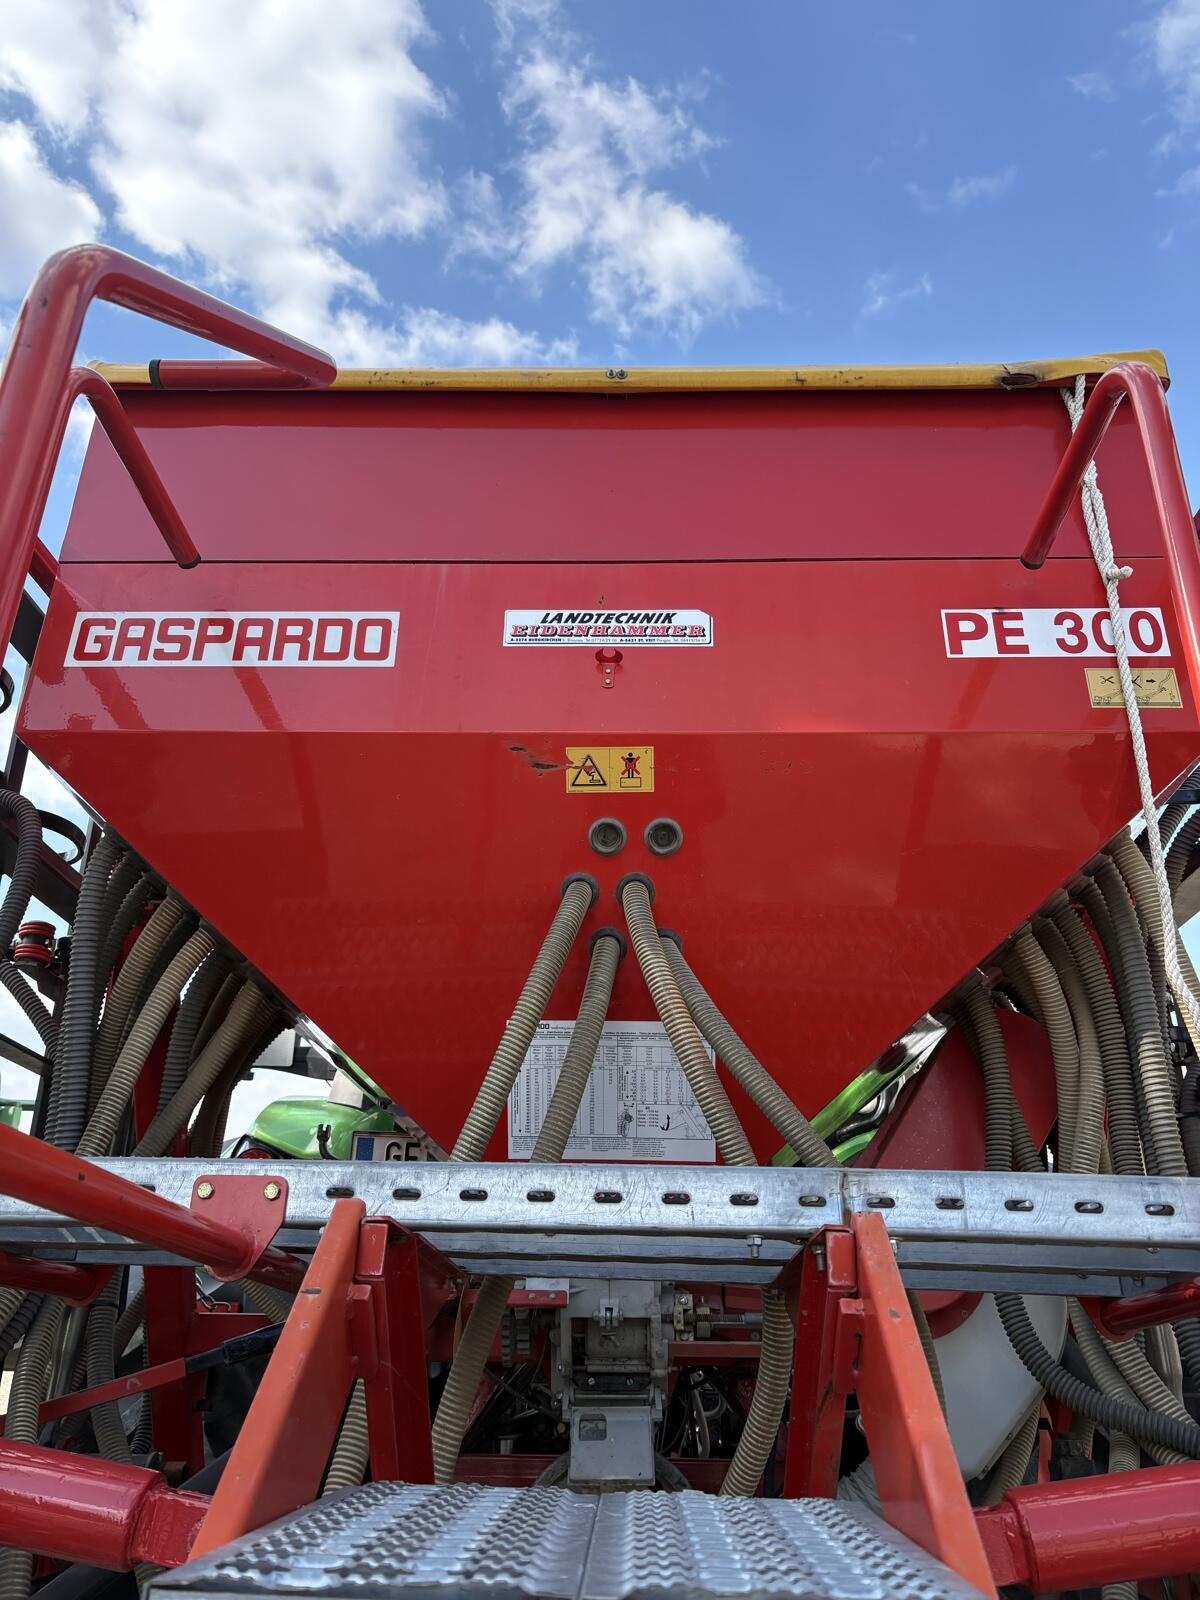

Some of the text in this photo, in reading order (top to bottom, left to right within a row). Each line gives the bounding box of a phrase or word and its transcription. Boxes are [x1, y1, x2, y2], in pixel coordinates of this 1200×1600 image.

[510, 624, 706, 637] EIDENHAMMER
[540, 612, 677, 624] LANDTECHNIK
[944, 610, 1164, 655] PE 300
[73, 617, 392, 662] GASPARDO
